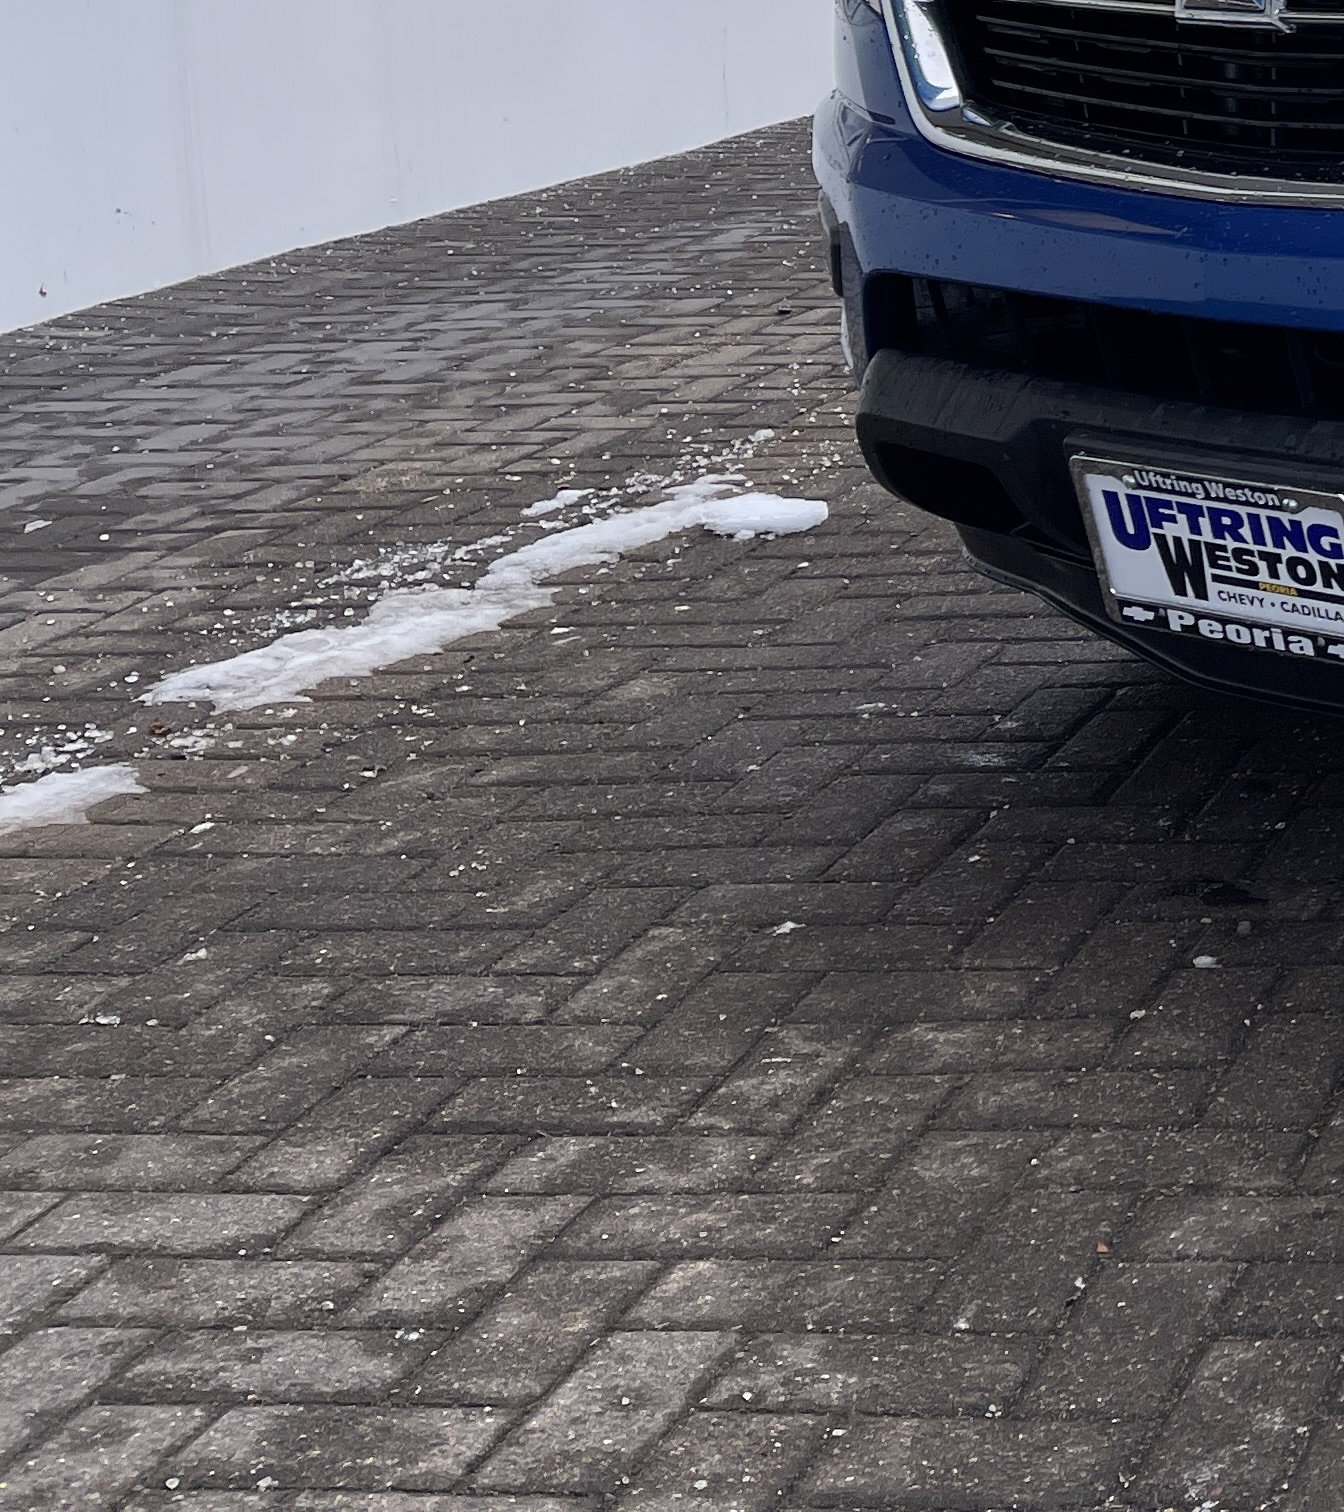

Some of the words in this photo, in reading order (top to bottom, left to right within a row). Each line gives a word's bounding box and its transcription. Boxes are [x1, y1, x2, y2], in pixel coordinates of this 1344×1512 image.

[1134, 470, 1205, 500] Uftring
[1205, 481, 1281, 507] Weston
[1101, 489, 1344, 561] UFTRING
[1217, 590, 1265, 609] CHEVY
[1257, 581, 1299, 597] PEORIA
[1166, 609, 1315, 657] Peoria
